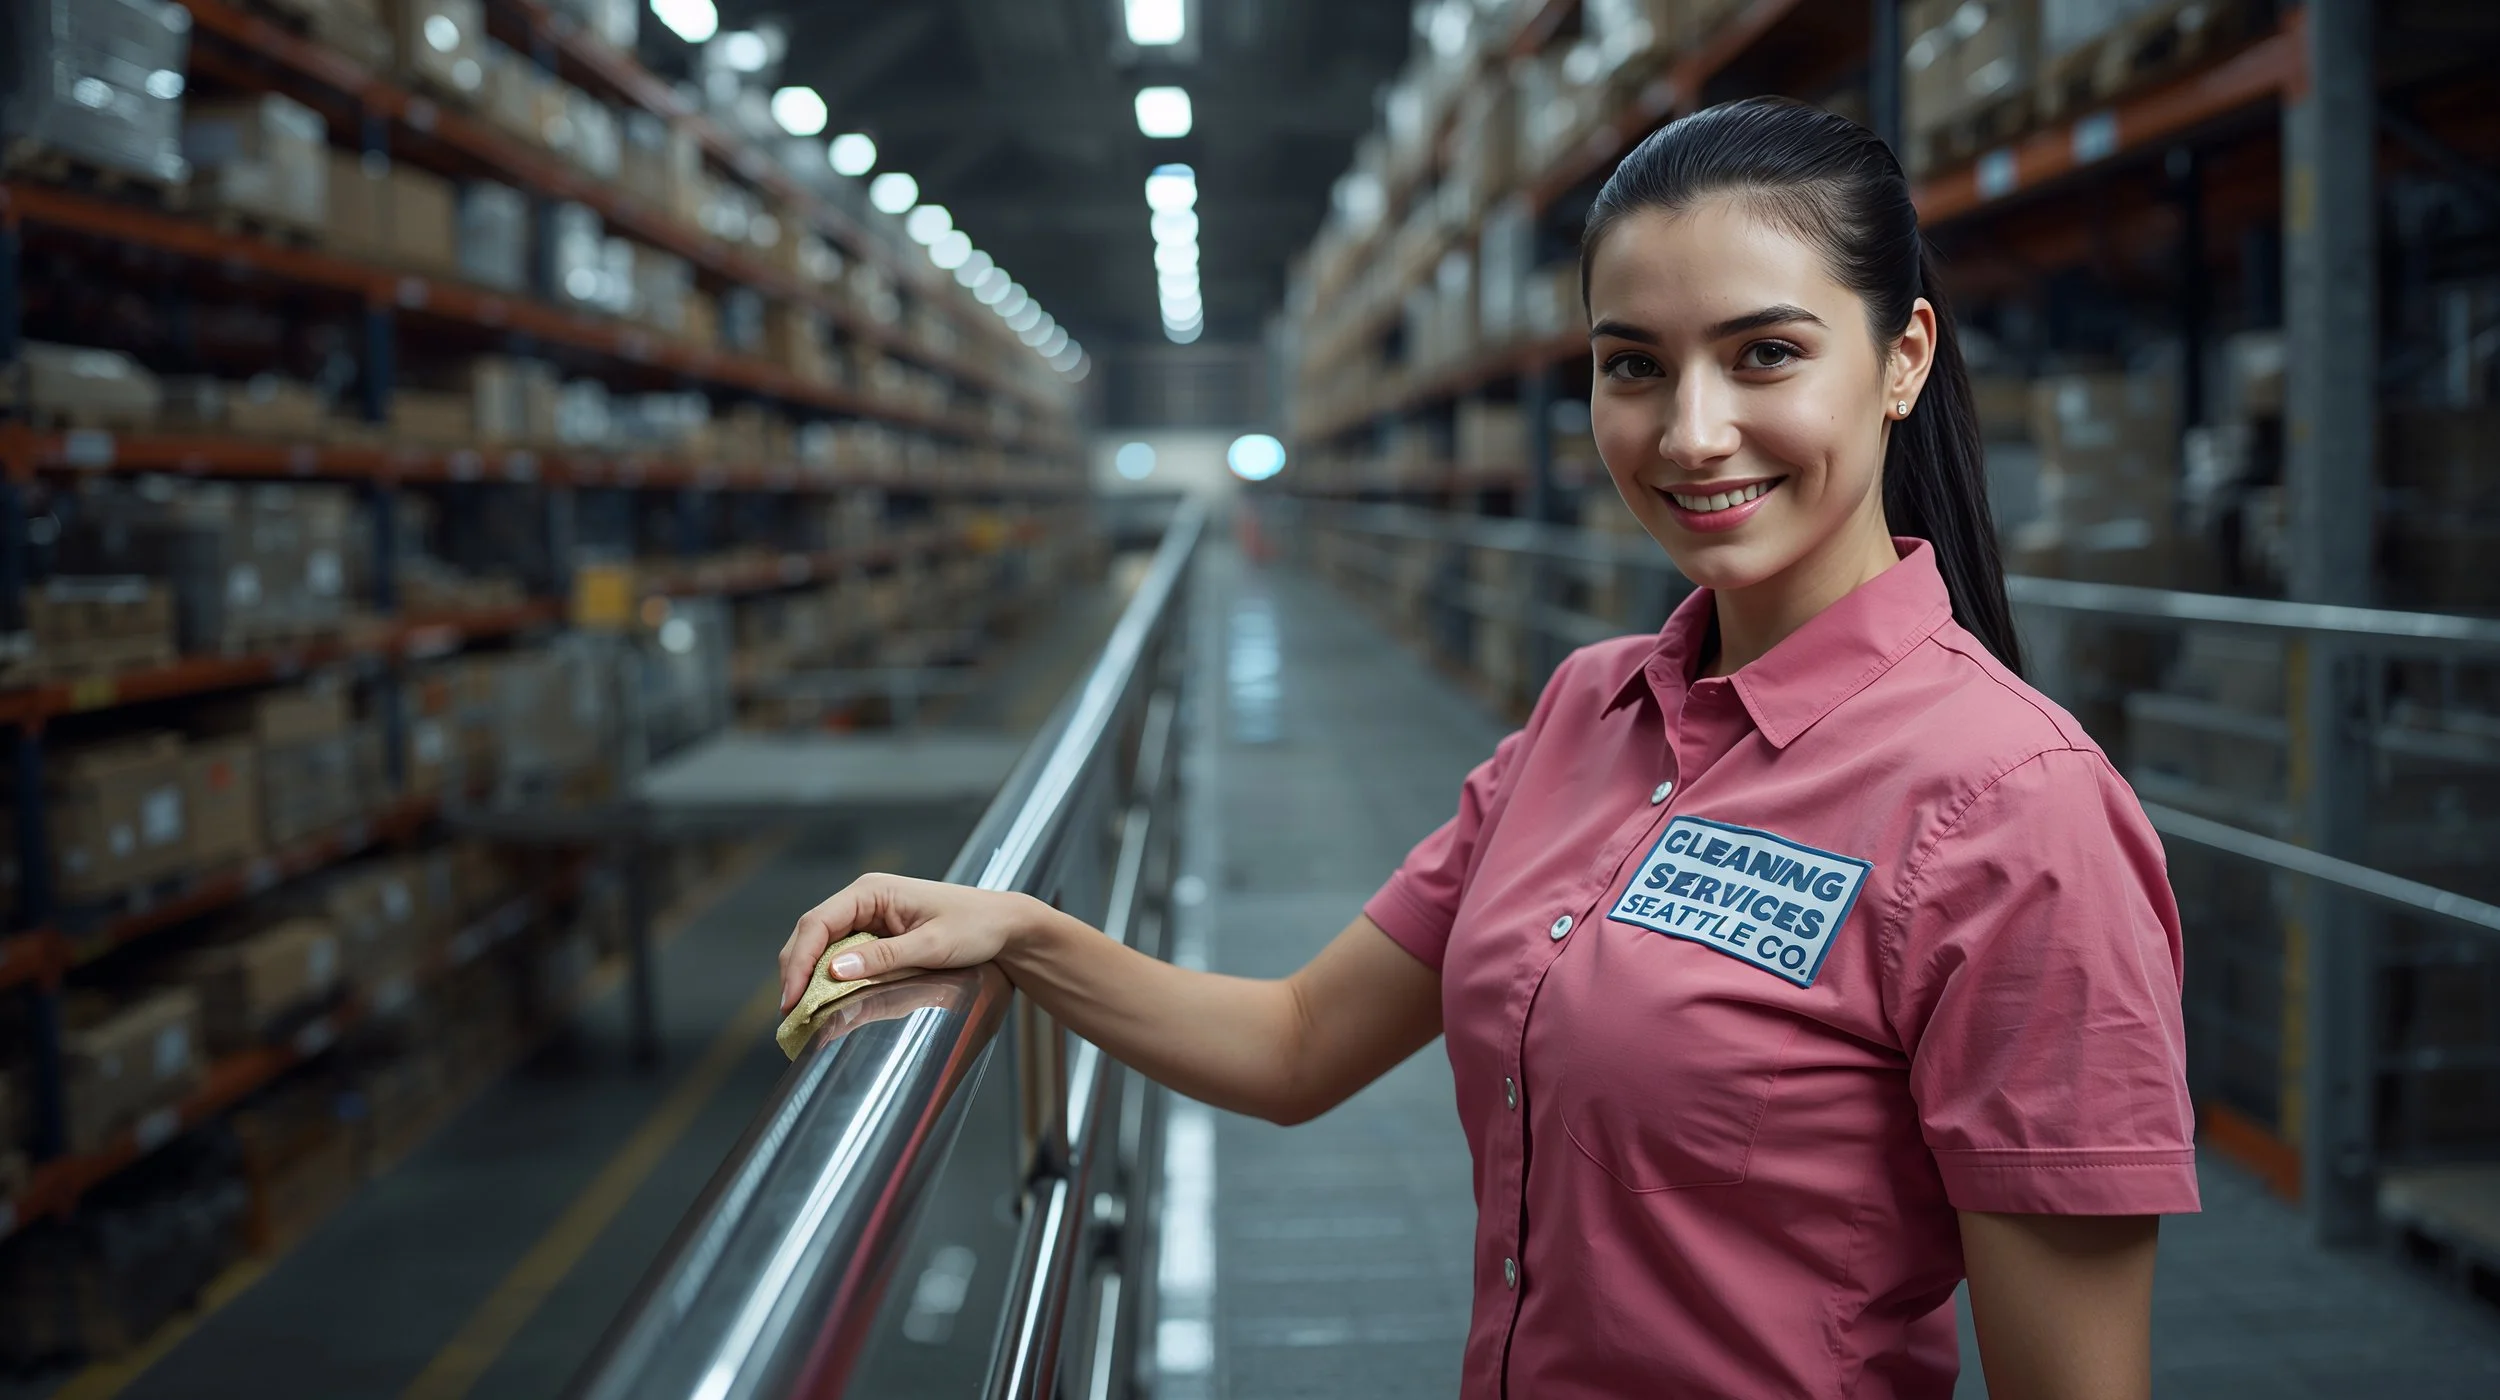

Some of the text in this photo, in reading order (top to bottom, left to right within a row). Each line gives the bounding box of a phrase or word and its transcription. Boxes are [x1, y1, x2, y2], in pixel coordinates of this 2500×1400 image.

[1644, 862, 1825, 940] SERVICES
[1664, 829, 1848, 902] CLEANING
[1621, 894, 1807, 976] SEATTLE CO.
